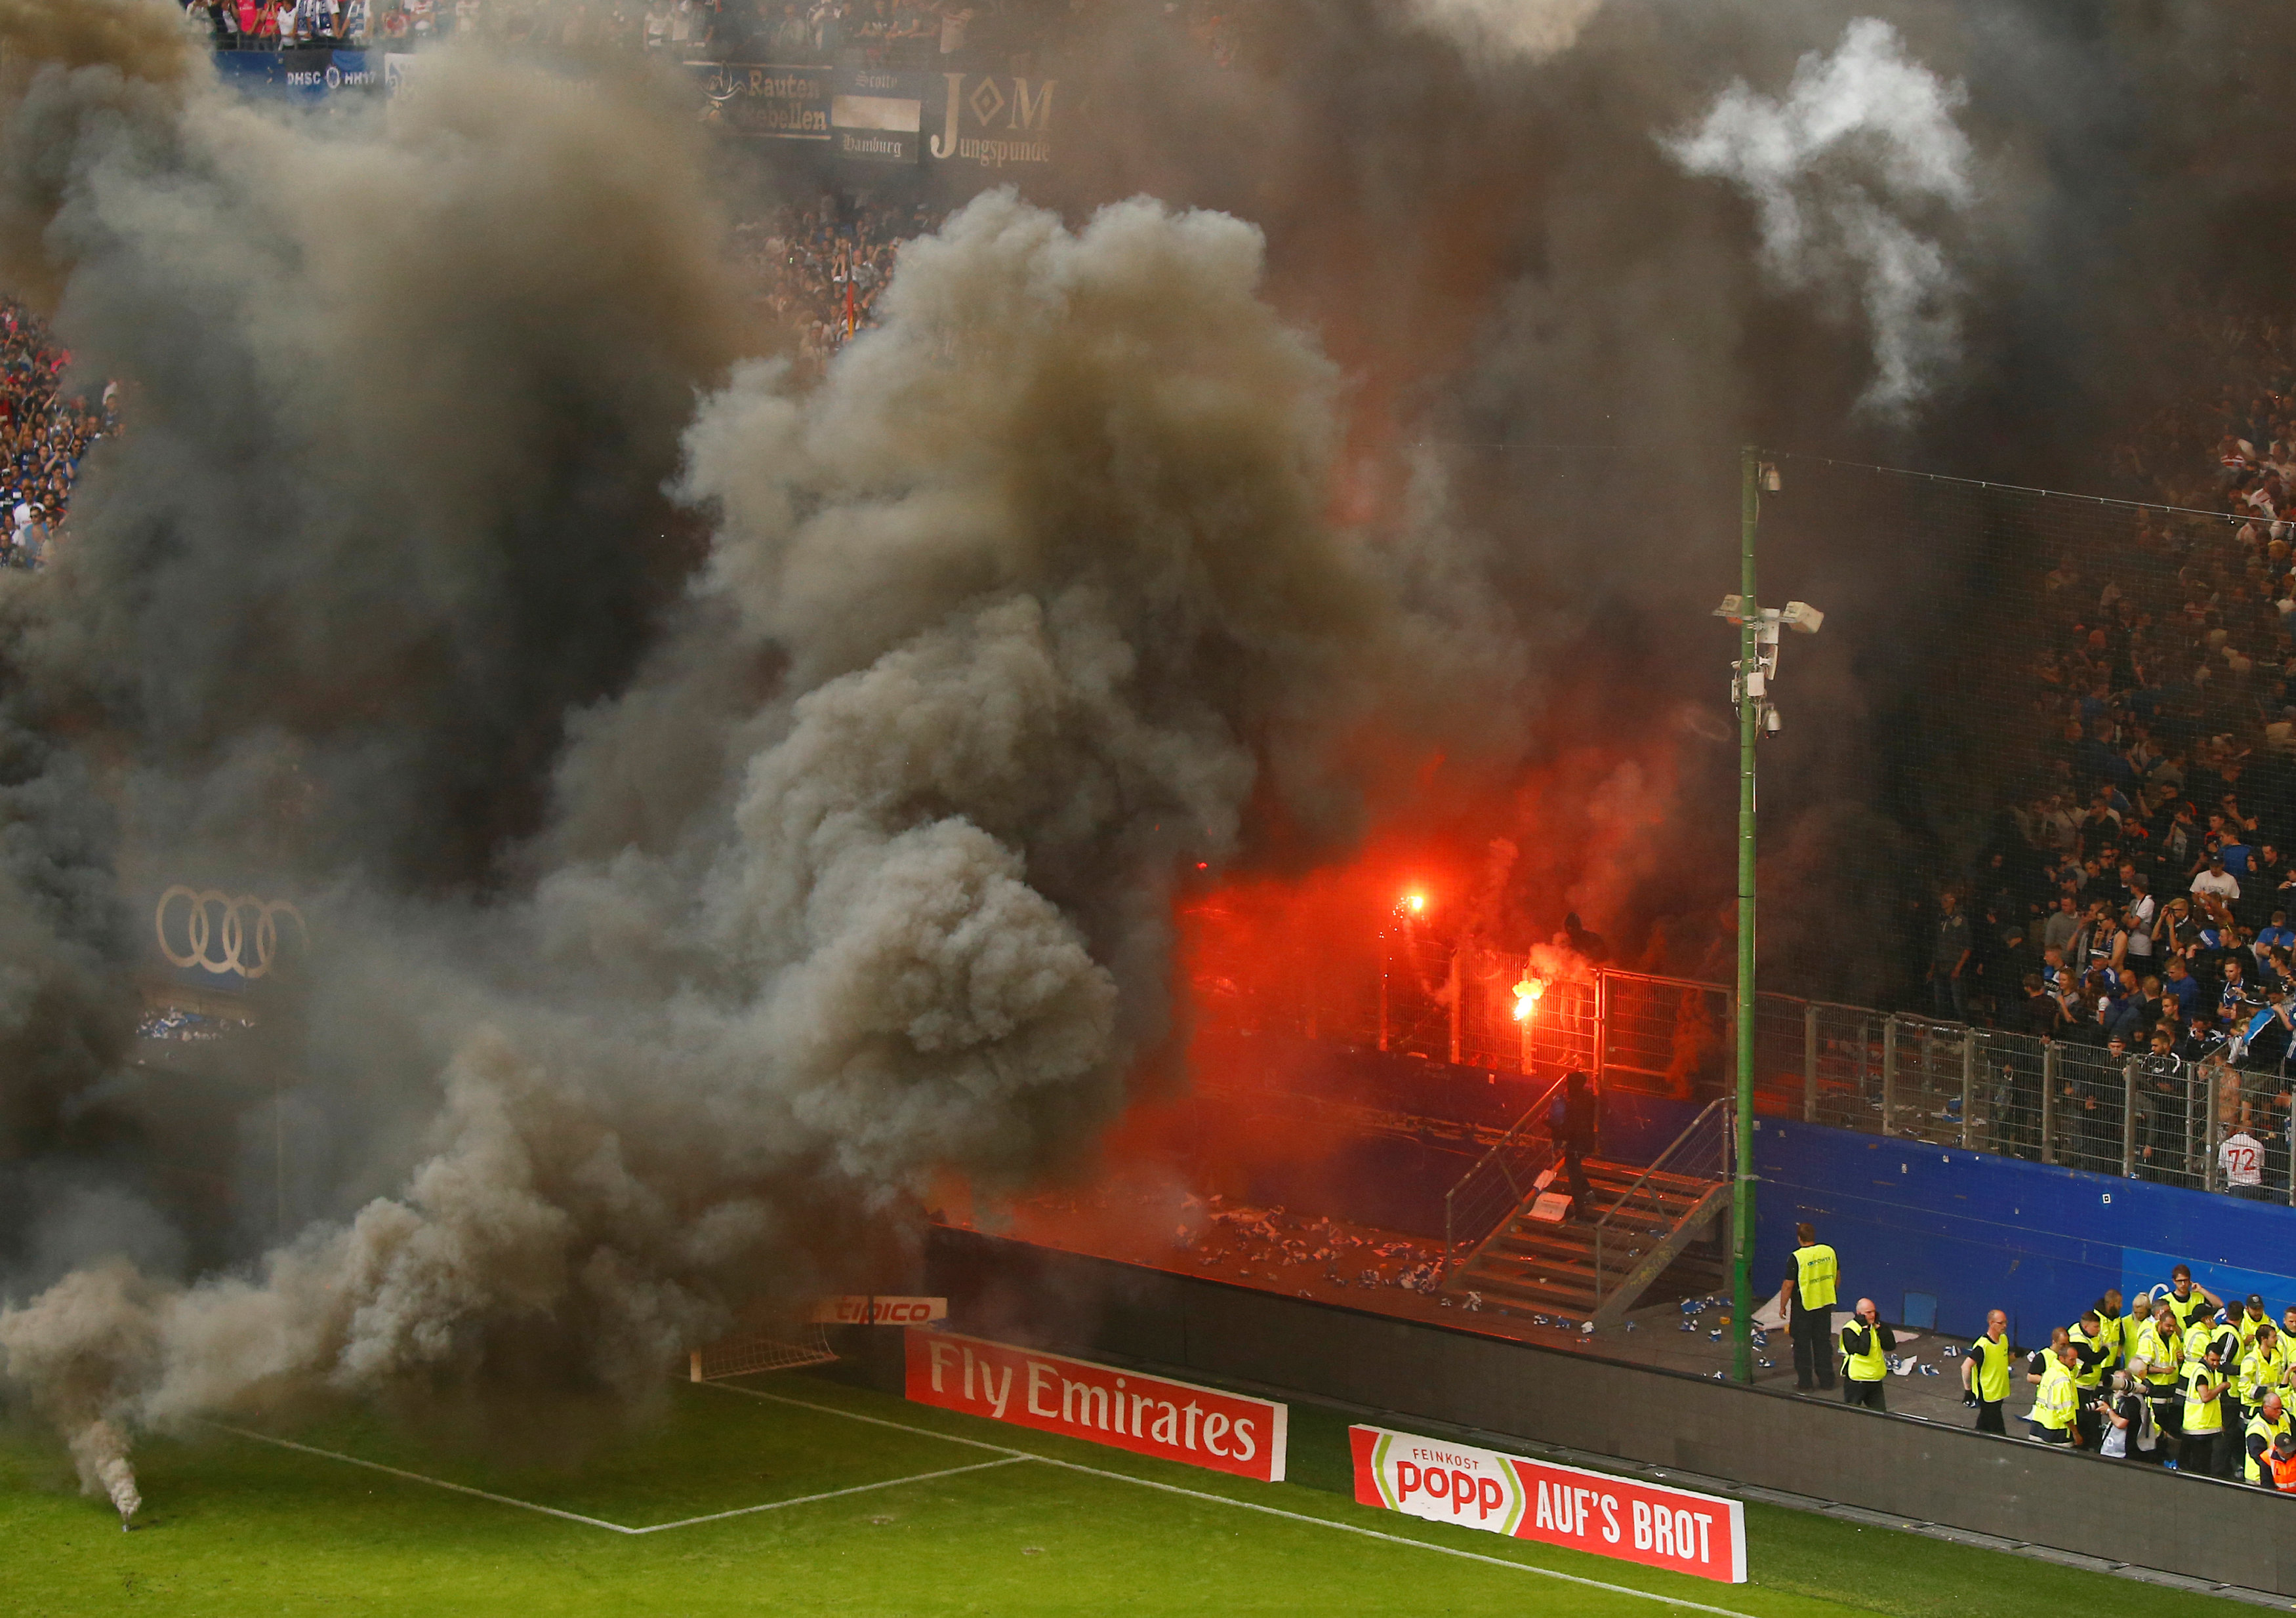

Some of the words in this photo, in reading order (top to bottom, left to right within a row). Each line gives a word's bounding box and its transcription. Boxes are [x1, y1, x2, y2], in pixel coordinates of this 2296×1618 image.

[287, 70, 321, 85] DHSC
[748, 70, 820, 98] Rauten
[843, 133, 903, 157] Hamburg
[2228, 1148, 2255, 1172] 72
[835, 1296, 931, 1324] tipico
[927, 1339, 1013, 1419] Fly
[1027, 1360, 1256, 1462] Emirates
[1412, 1447, 1479, 1470] FEINKOST
[1536, 1480, 1621, 1544] AUF'S
[1632, 1499, 1713, 1564] BROT
